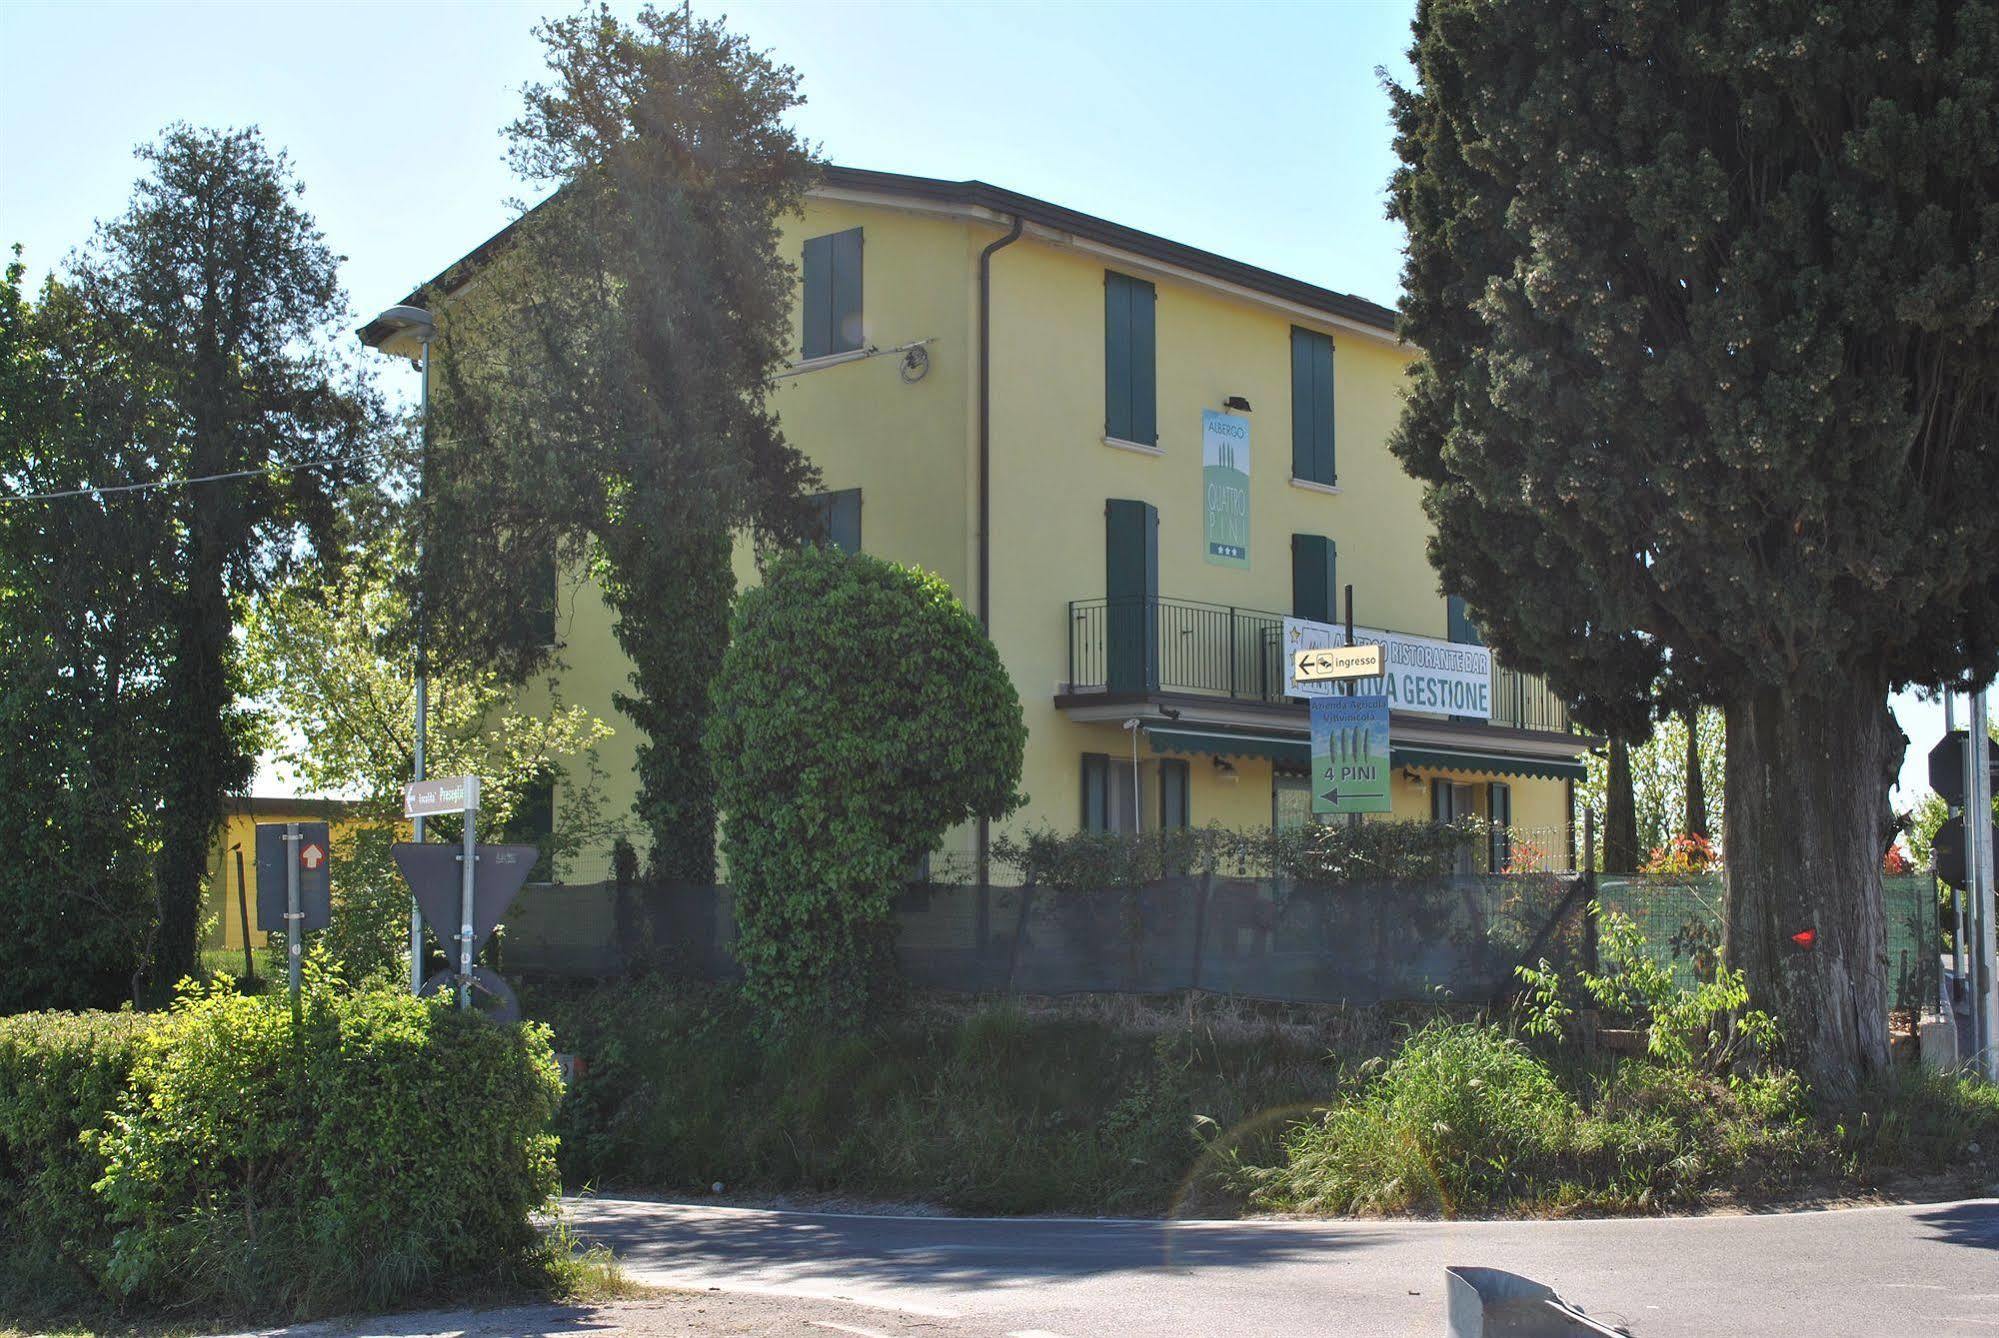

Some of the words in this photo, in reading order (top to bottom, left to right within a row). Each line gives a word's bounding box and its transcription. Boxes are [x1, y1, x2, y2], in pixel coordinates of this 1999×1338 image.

[1208, 421, 1244, 440] ALBERGO
[1335, 656, 1377, 669] ingresso
[1391, 642, 1464, 671] RISTORANTE
[1464, 651, 1488, 675] BAR
[1403, 677, 1488, 711] GESTIONE
[1312, 701, 1347, 712] Azienda
[1350, 700, 1387, 712] Agricola
[1323, 767, 1335, 781] 4
[1341, 766, 1377, 781] PINI
